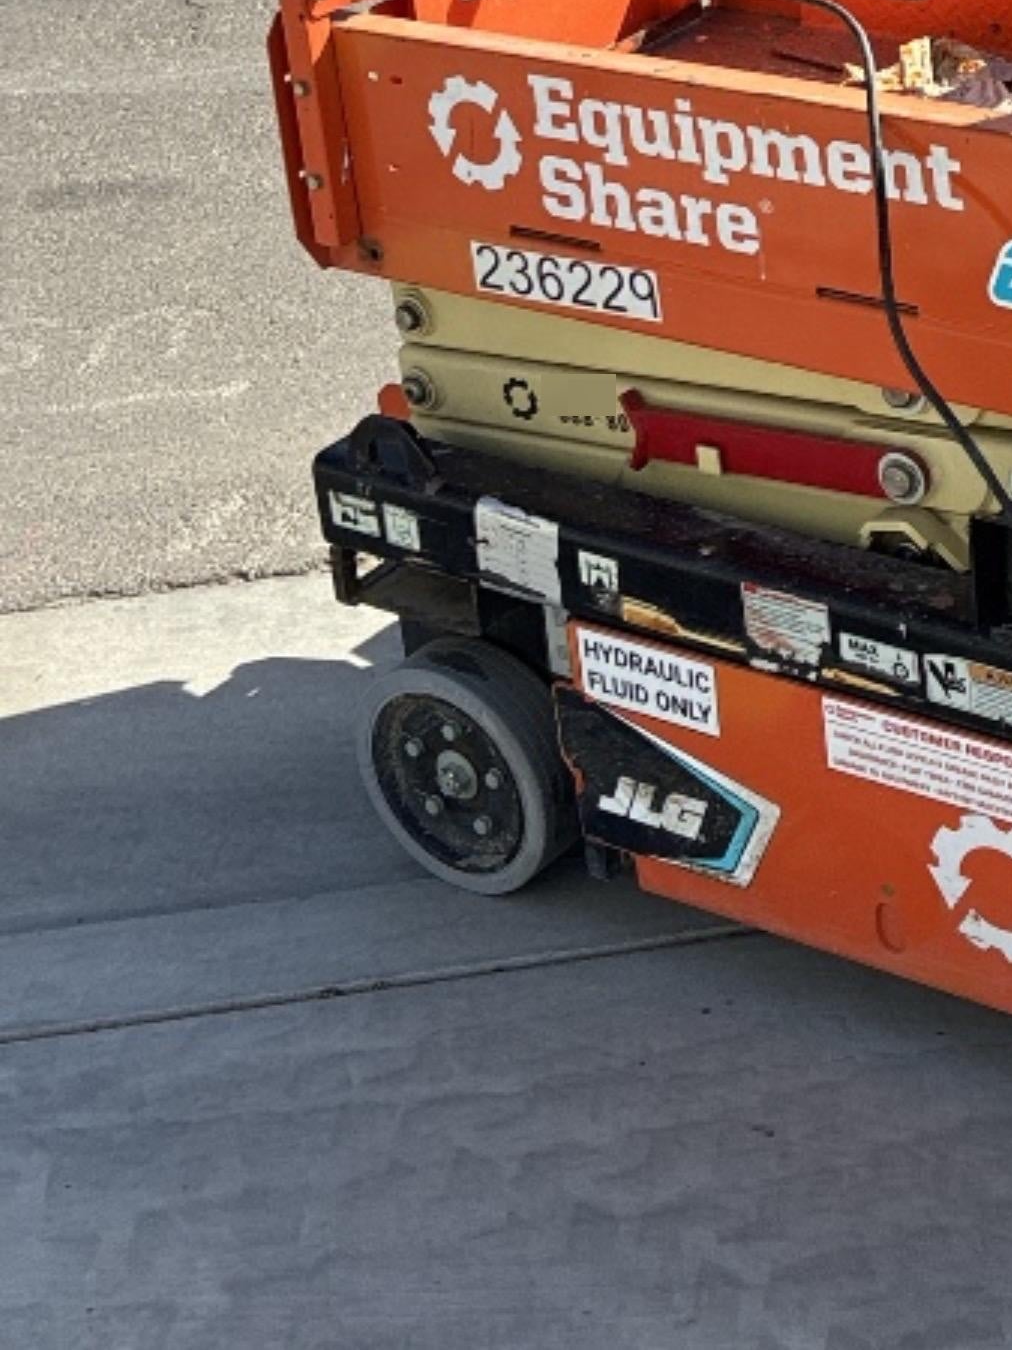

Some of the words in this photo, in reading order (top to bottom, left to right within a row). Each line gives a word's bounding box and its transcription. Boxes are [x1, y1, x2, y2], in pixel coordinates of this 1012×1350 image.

[528, 73, 964, 211] Equipment
[539, 154, 761, 254] Share
[476, 245, 658, 318] 236229
[583, 638, 711, 694] HYDRAULIC
[587, 670, 649, 706] FLUID
[656, 689, 712, 724] ONLY
[598, 776, 710, 843] JLG
